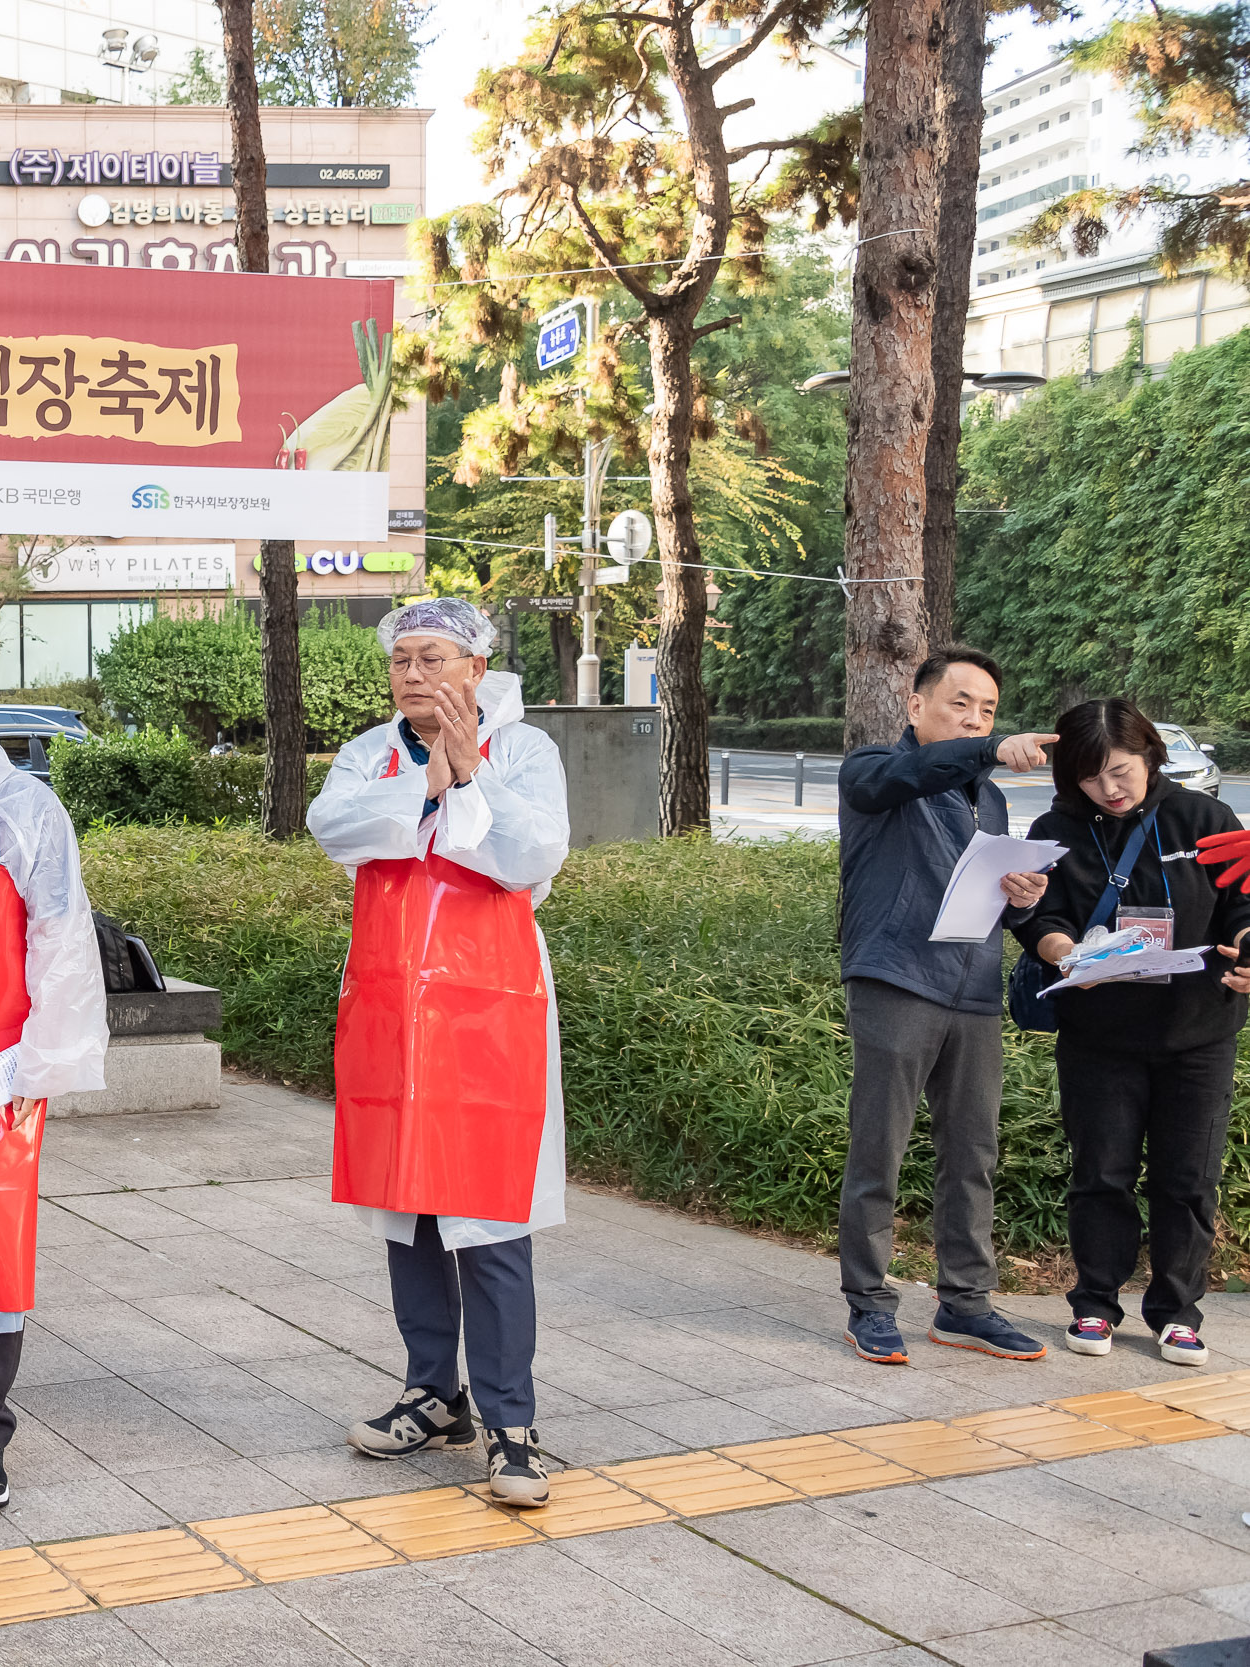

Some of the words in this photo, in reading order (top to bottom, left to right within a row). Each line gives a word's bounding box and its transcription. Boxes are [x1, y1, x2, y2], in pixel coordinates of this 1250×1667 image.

[319, 169, 383, 181] 02.465.0987
[22, 487, 82, 507] 국민은행
[173, 494, 271, 511] 한국사회보장정보원
[68, 557, 116, 572] WHY
[127, 557, 224, 571] PILATES
[310, 549, 360, 576] CU
[639, 723, 652, 734] 10
